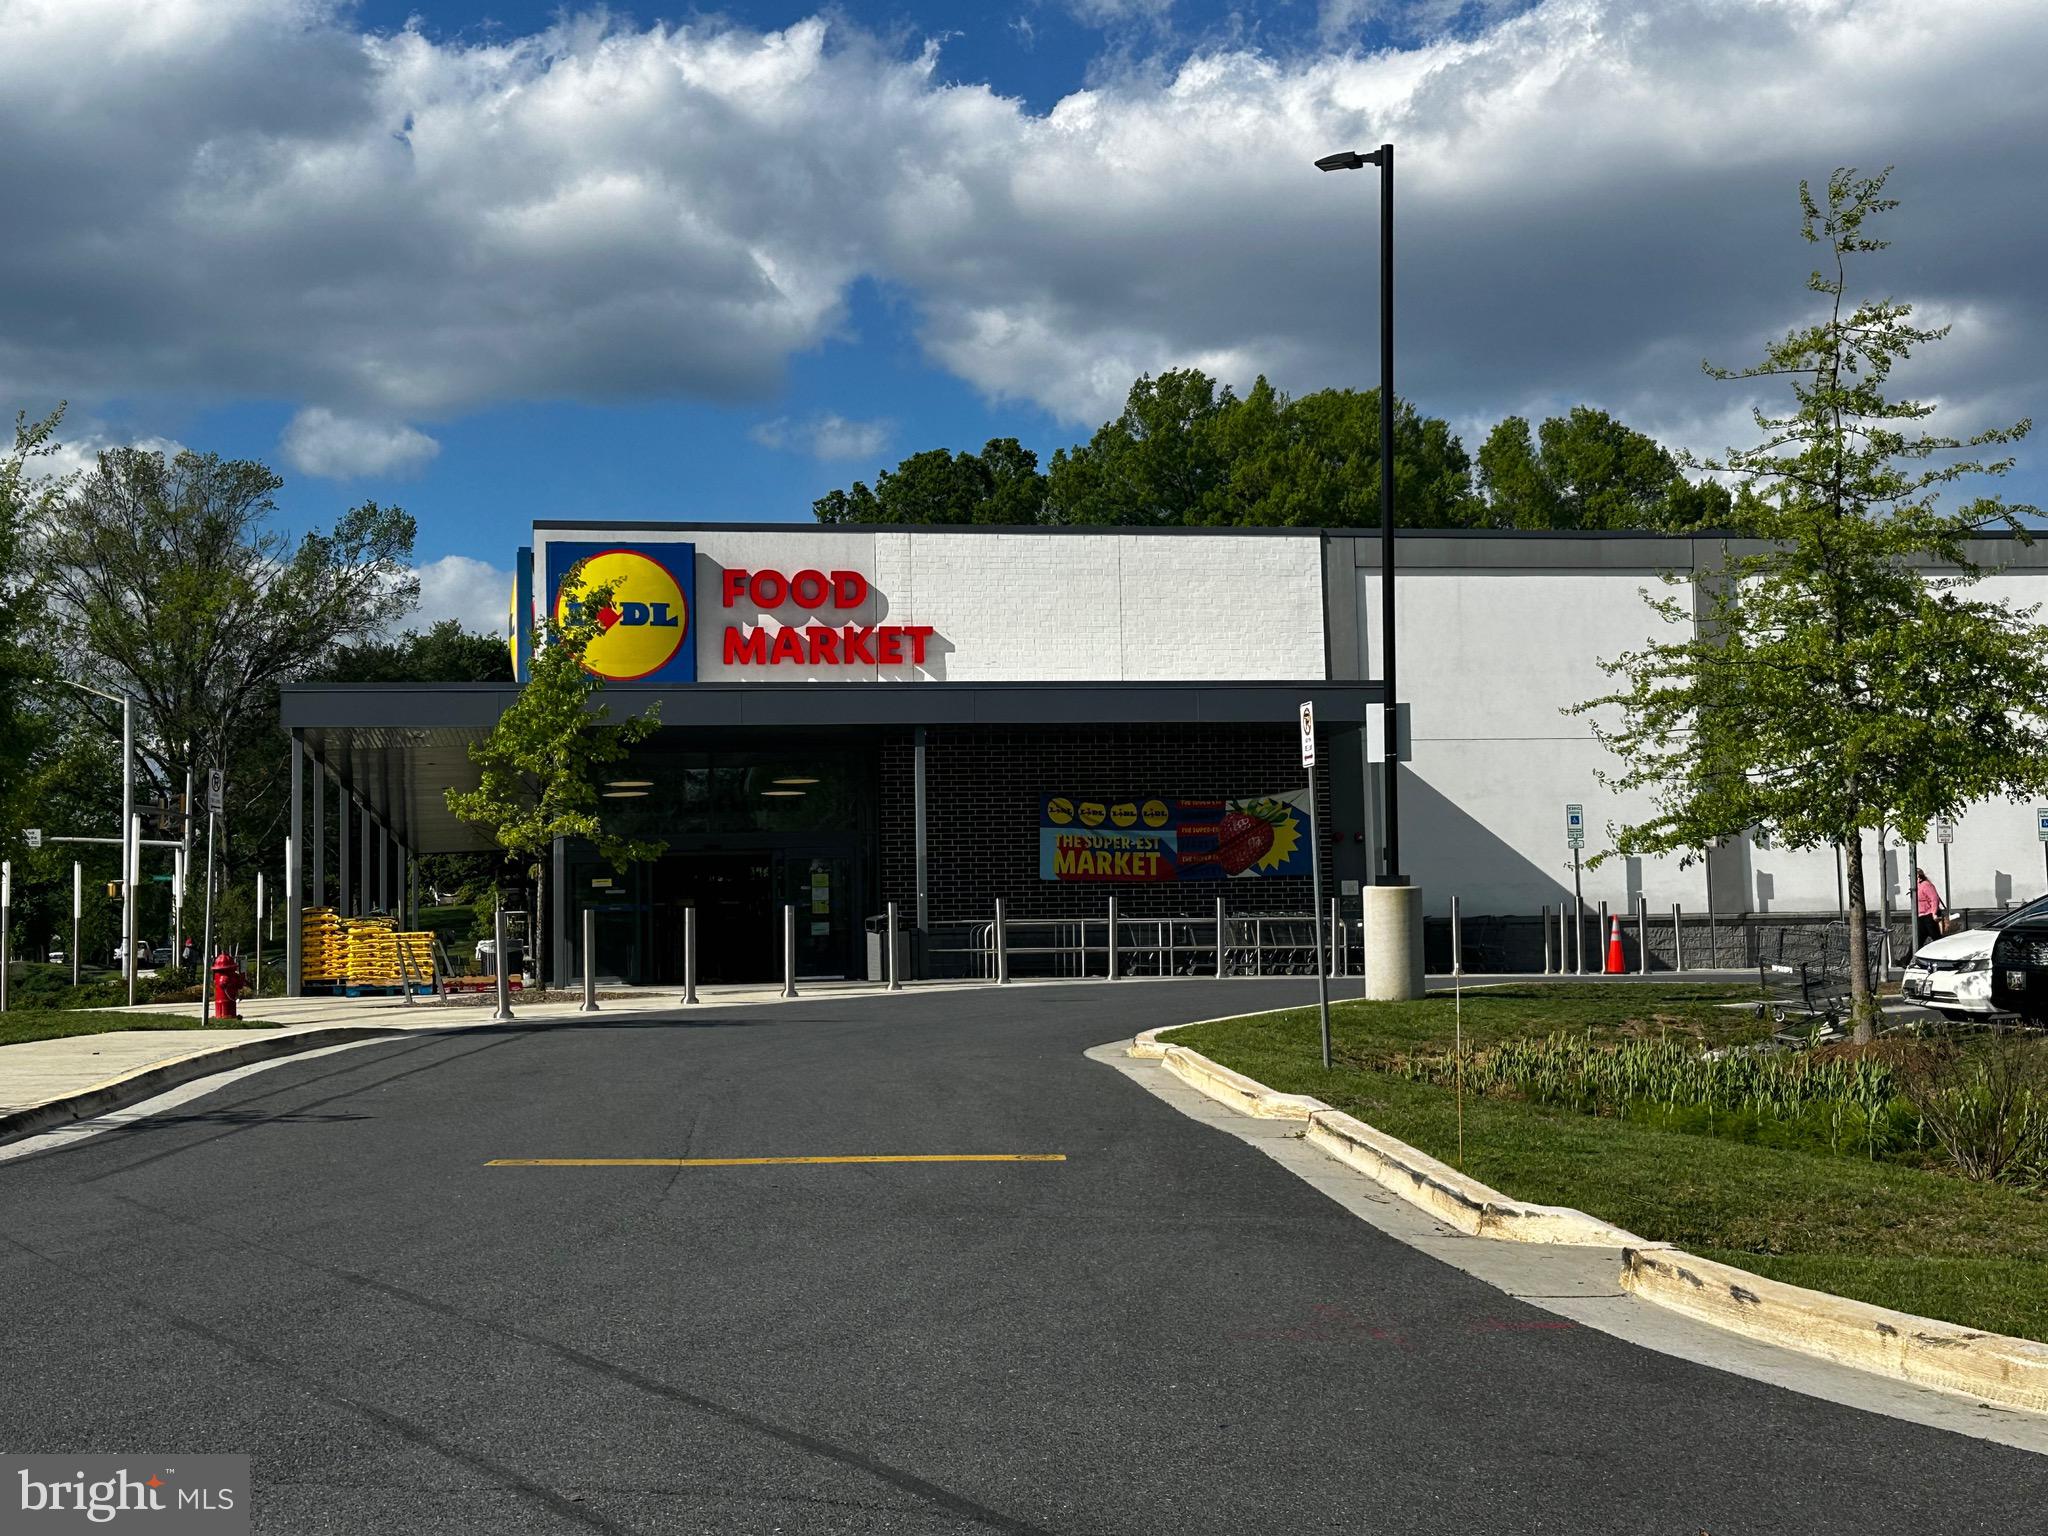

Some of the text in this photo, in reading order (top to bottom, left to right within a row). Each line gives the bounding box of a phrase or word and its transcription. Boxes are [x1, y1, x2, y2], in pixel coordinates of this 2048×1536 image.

[722, 568, 868, 609] FOOD
[723, 625, 934, 665] MARKET
[1055, 834, 1160, 850] THE SUPER-EST
[1053, 849, 1161, 876] MARKET
